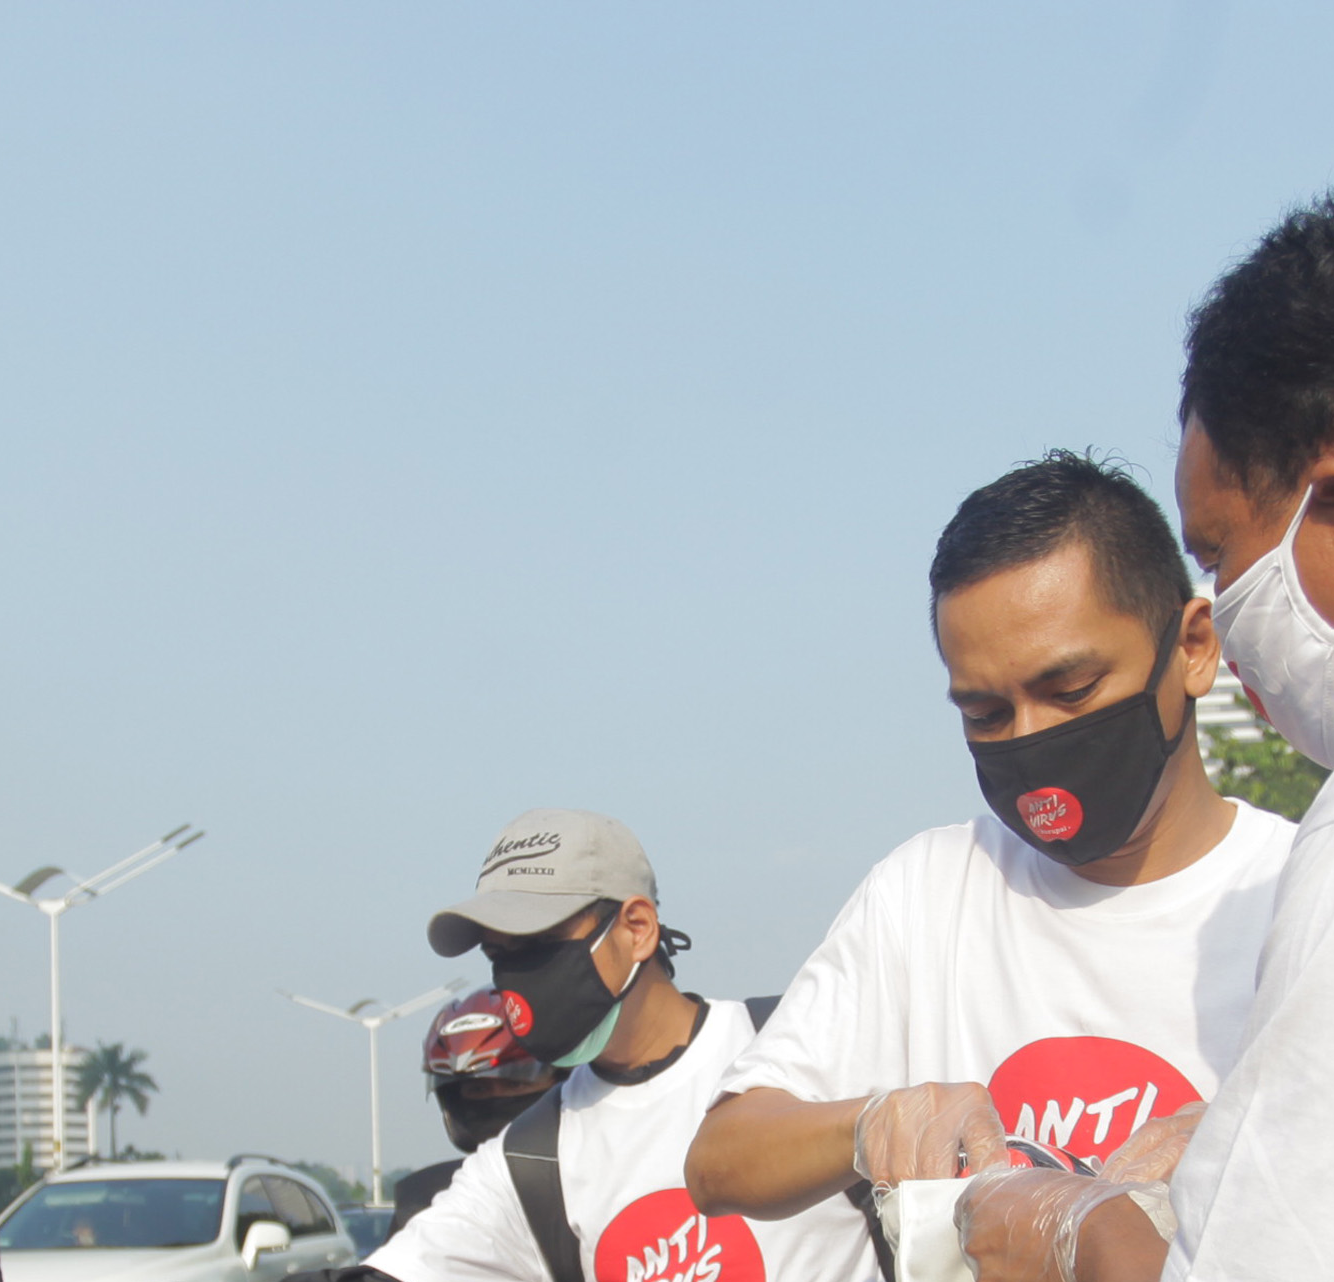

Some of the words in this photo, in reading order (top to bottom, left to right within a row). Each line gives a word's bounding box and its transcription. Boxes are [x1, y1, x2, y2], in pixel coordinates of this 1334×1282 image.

[1029, 794, 1058, 813] ANTI
[1029, 803, 1067, 827] VIRUS
[1015, 1081, 1158, 1149] ANTI
